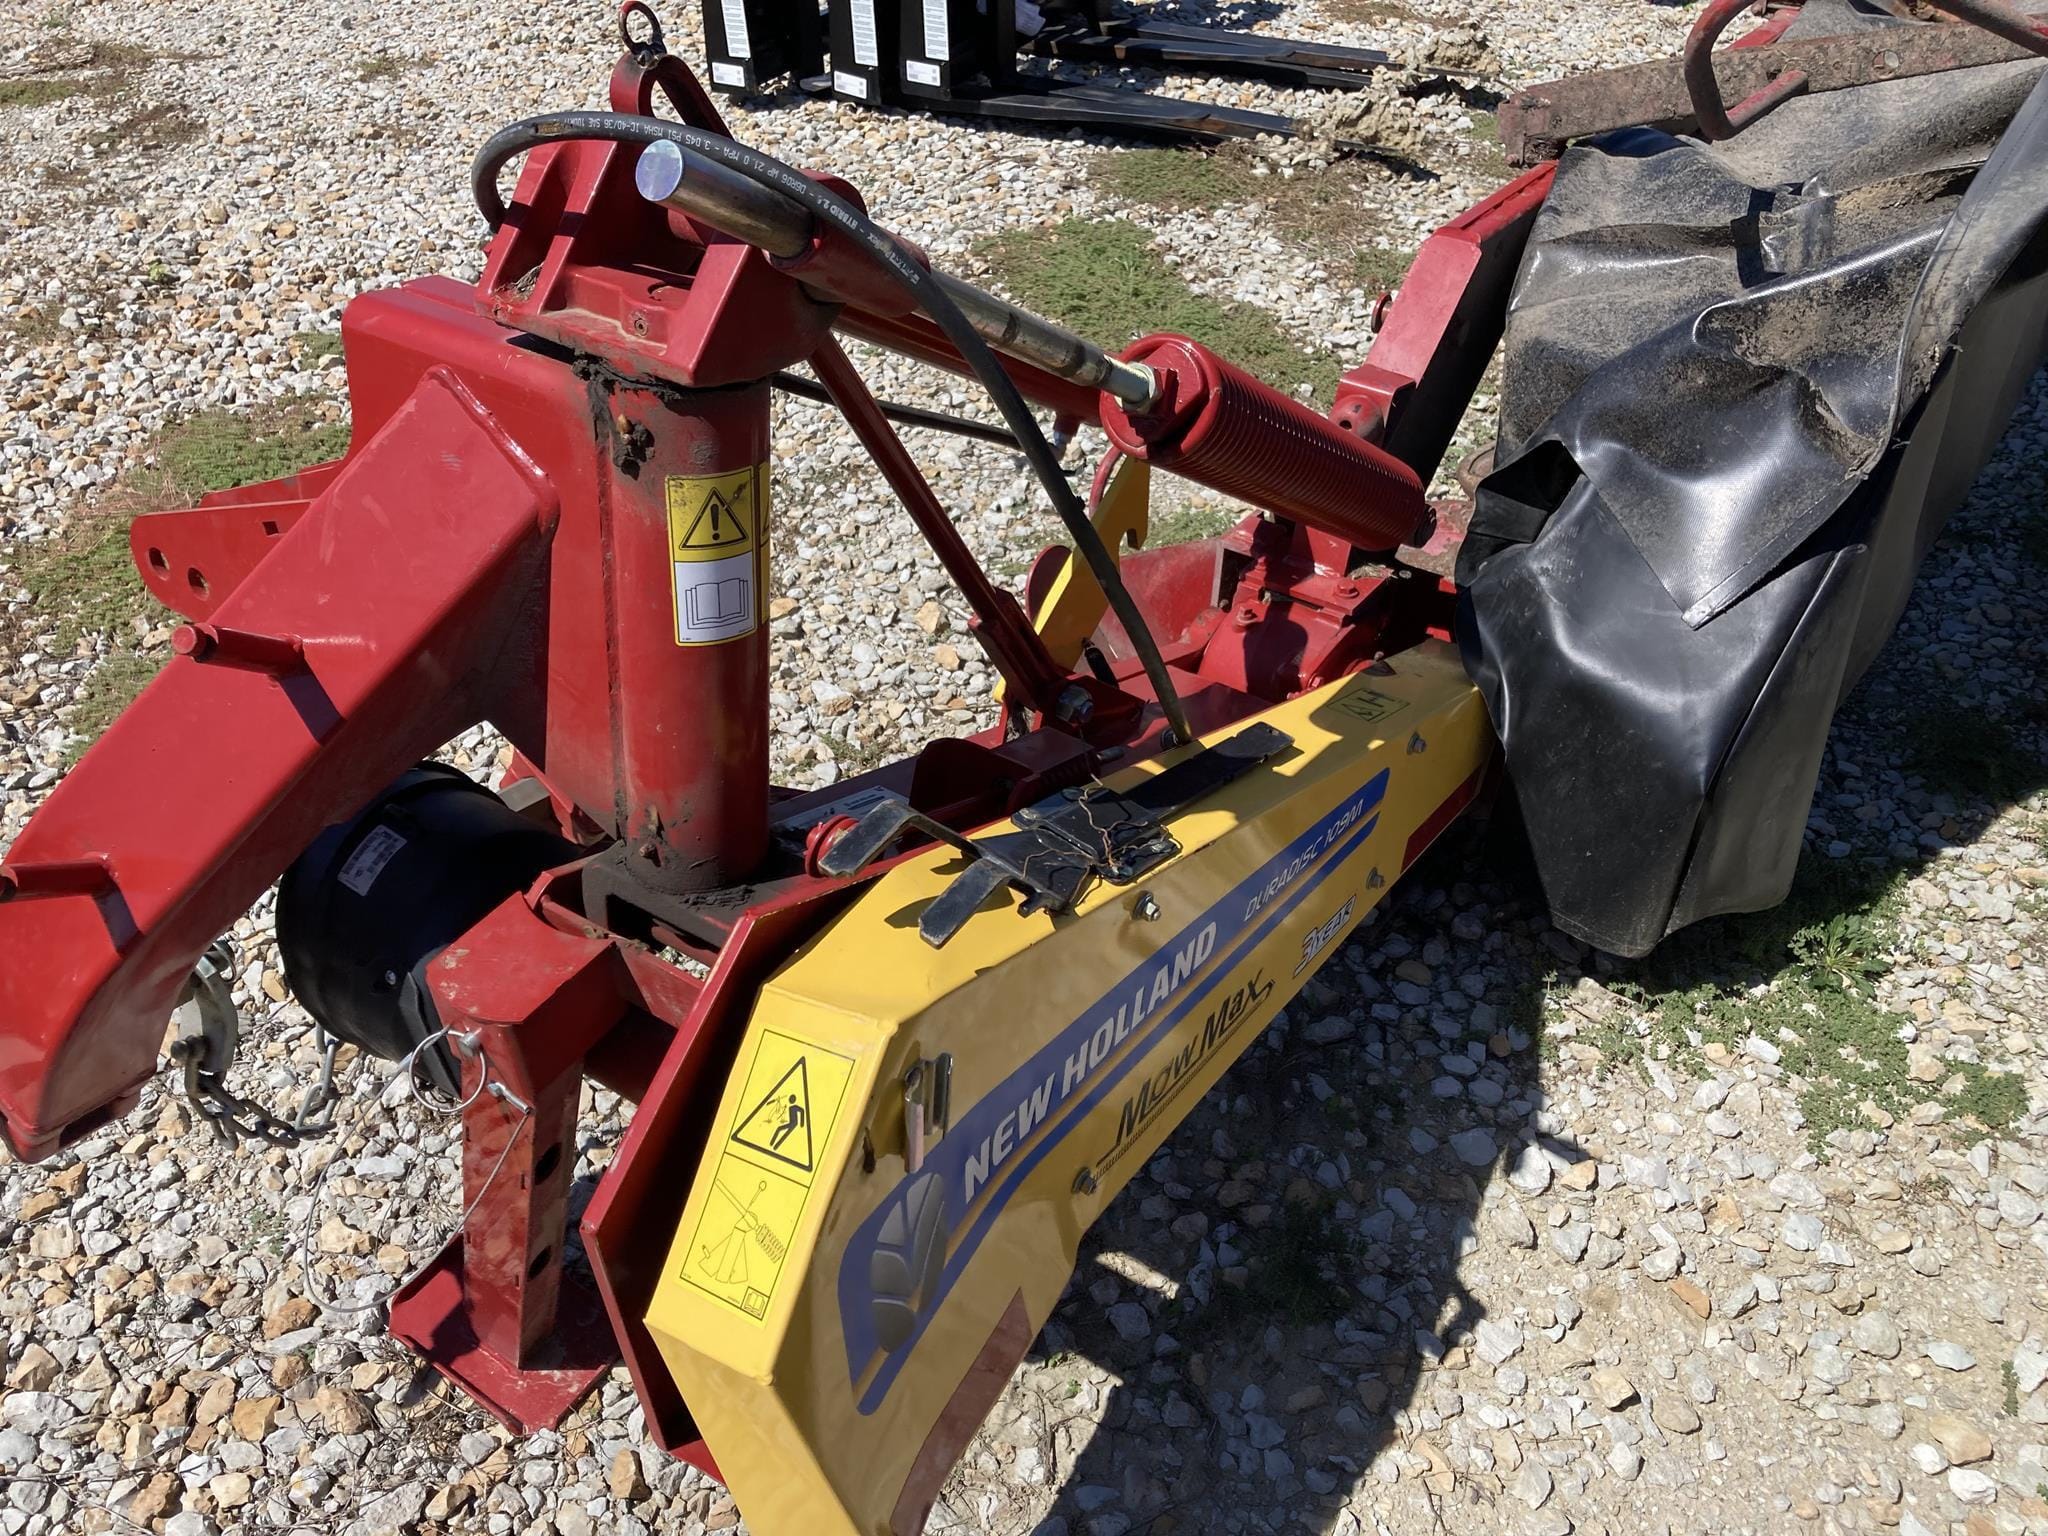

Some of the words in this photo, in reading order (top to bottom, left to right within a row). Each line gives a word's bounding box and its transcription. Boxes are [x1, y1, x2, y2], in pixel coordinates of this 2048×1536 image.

[587, 118, 601, 128] SAE
[604, 119, 640, 133] IC-40/36
[643, 125, 664, 137] MSHA
[667, 129, 682, 142] PSI
[723, 146, 740, 161] MPA
[767, 167, 779, 179] WP
[829, 205, 859, 230] HYBRID
[1243, 846, 1322, 922] DURADISC
[1322, 798, 1366, 848] 109M
[963, 1073, 1056, 1205] NEW
[1060, 920, 1217, 1100] HOLLAND
